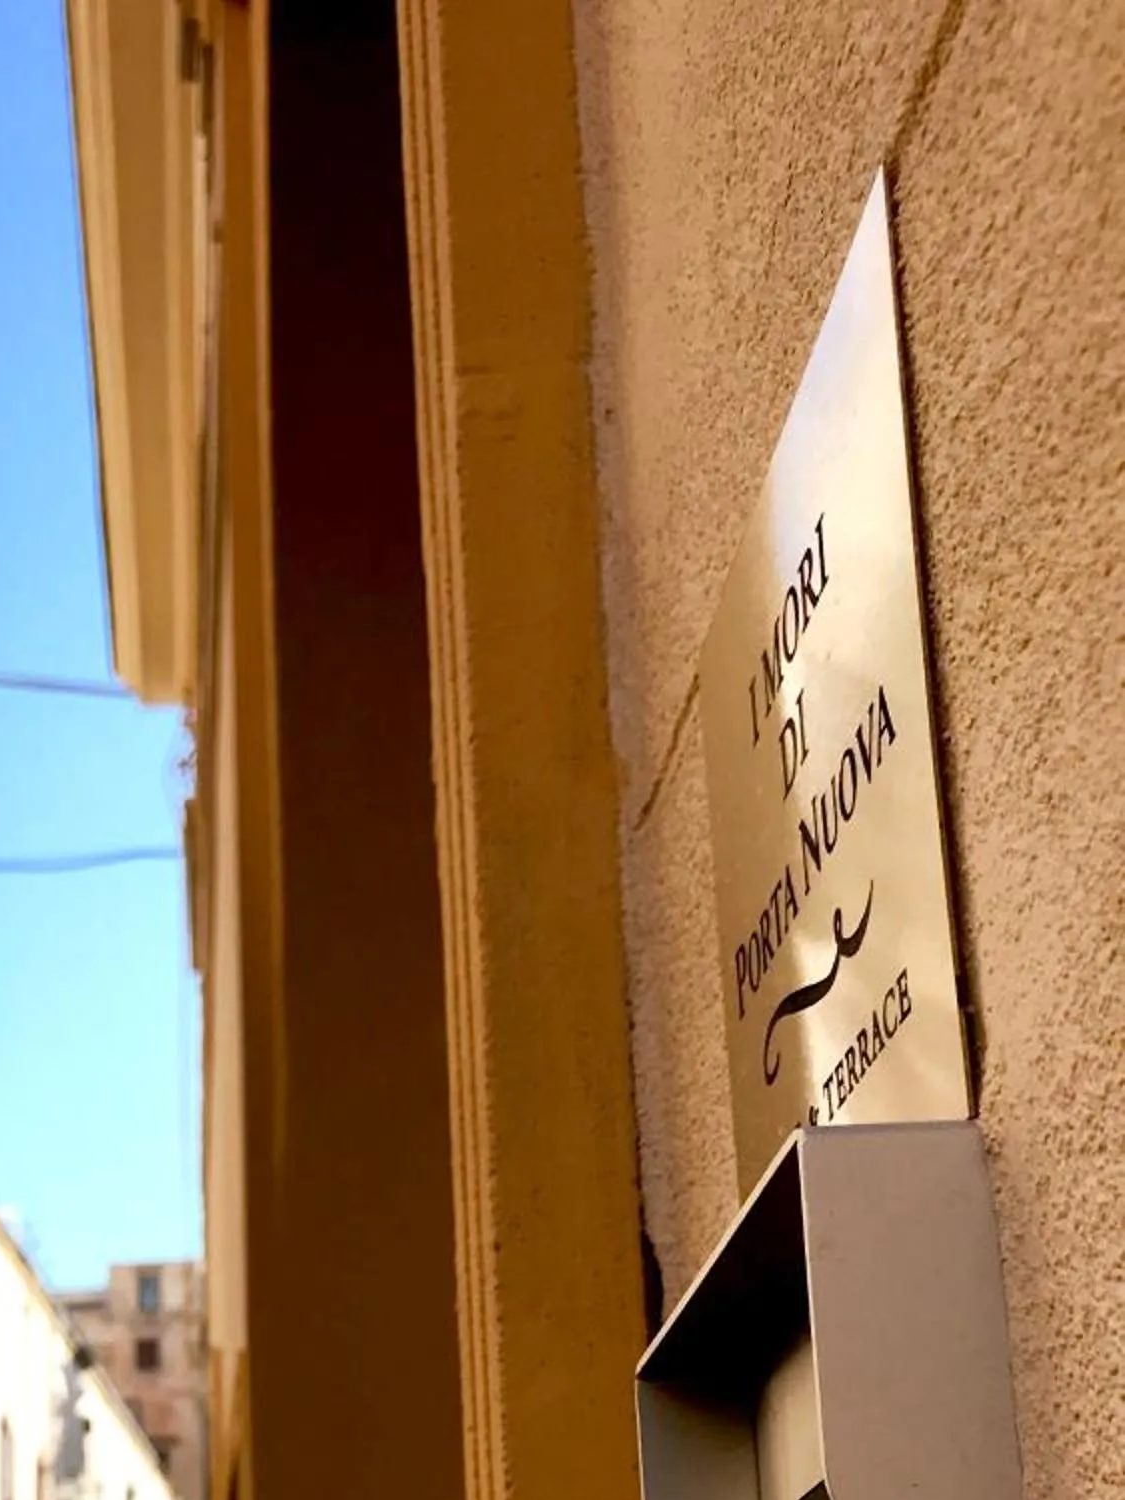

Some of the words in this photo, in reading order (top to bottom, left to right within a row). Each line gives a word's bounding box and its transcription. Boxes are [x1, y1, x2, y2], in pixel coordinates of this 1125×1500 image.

[748, 674, 760, 748] I
[760, 511, 830, 720] MORI
[778, 687, 810, 802] DI
[734, 863, 800, 1021] PORTA
[797, 684, 897, 897] NUOVA
[822, 965, 913, 1122] TERRACE
